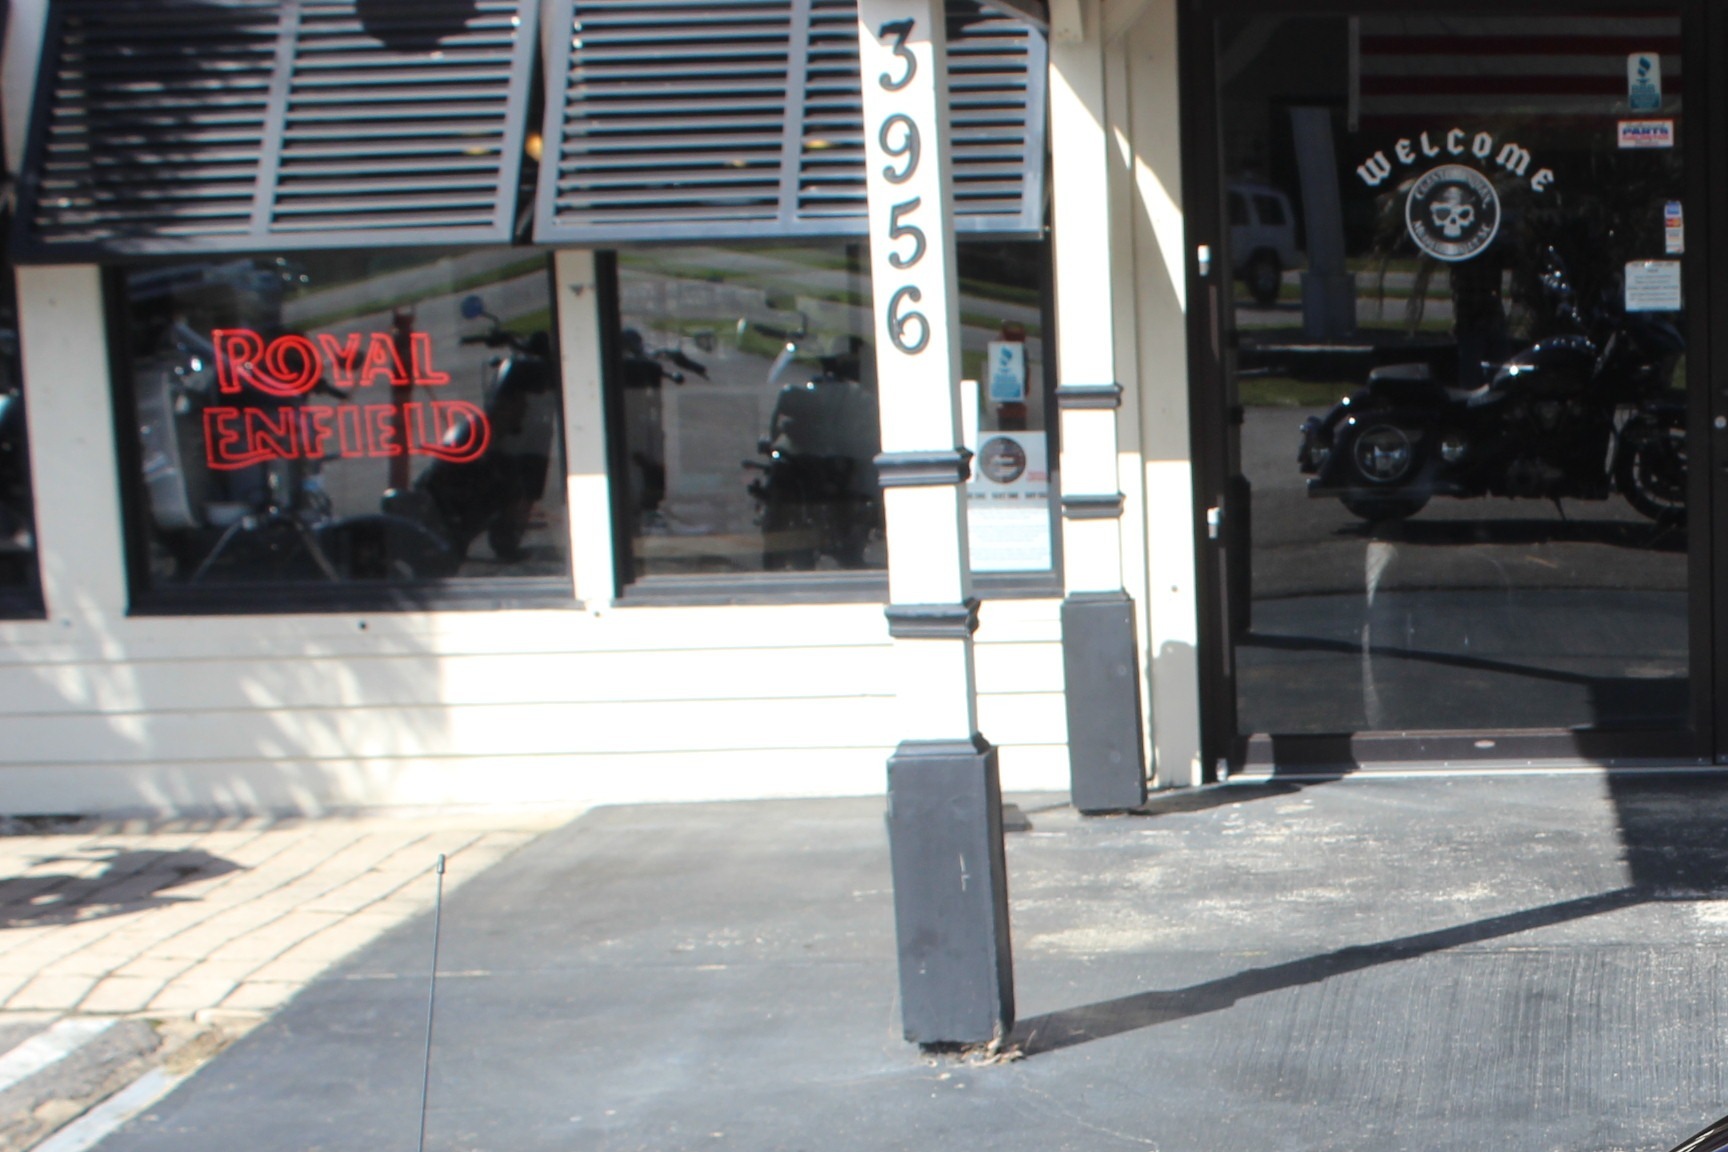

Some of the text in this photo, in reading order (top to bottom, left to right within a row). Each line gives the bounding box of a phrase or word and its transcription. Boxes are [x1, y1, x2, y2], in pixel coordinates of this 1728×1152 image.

[878, 17, 930, 355] 3956
[211, 328, 452, 397] ROYAL
[202, 400, 491, 471] ENFIELD
